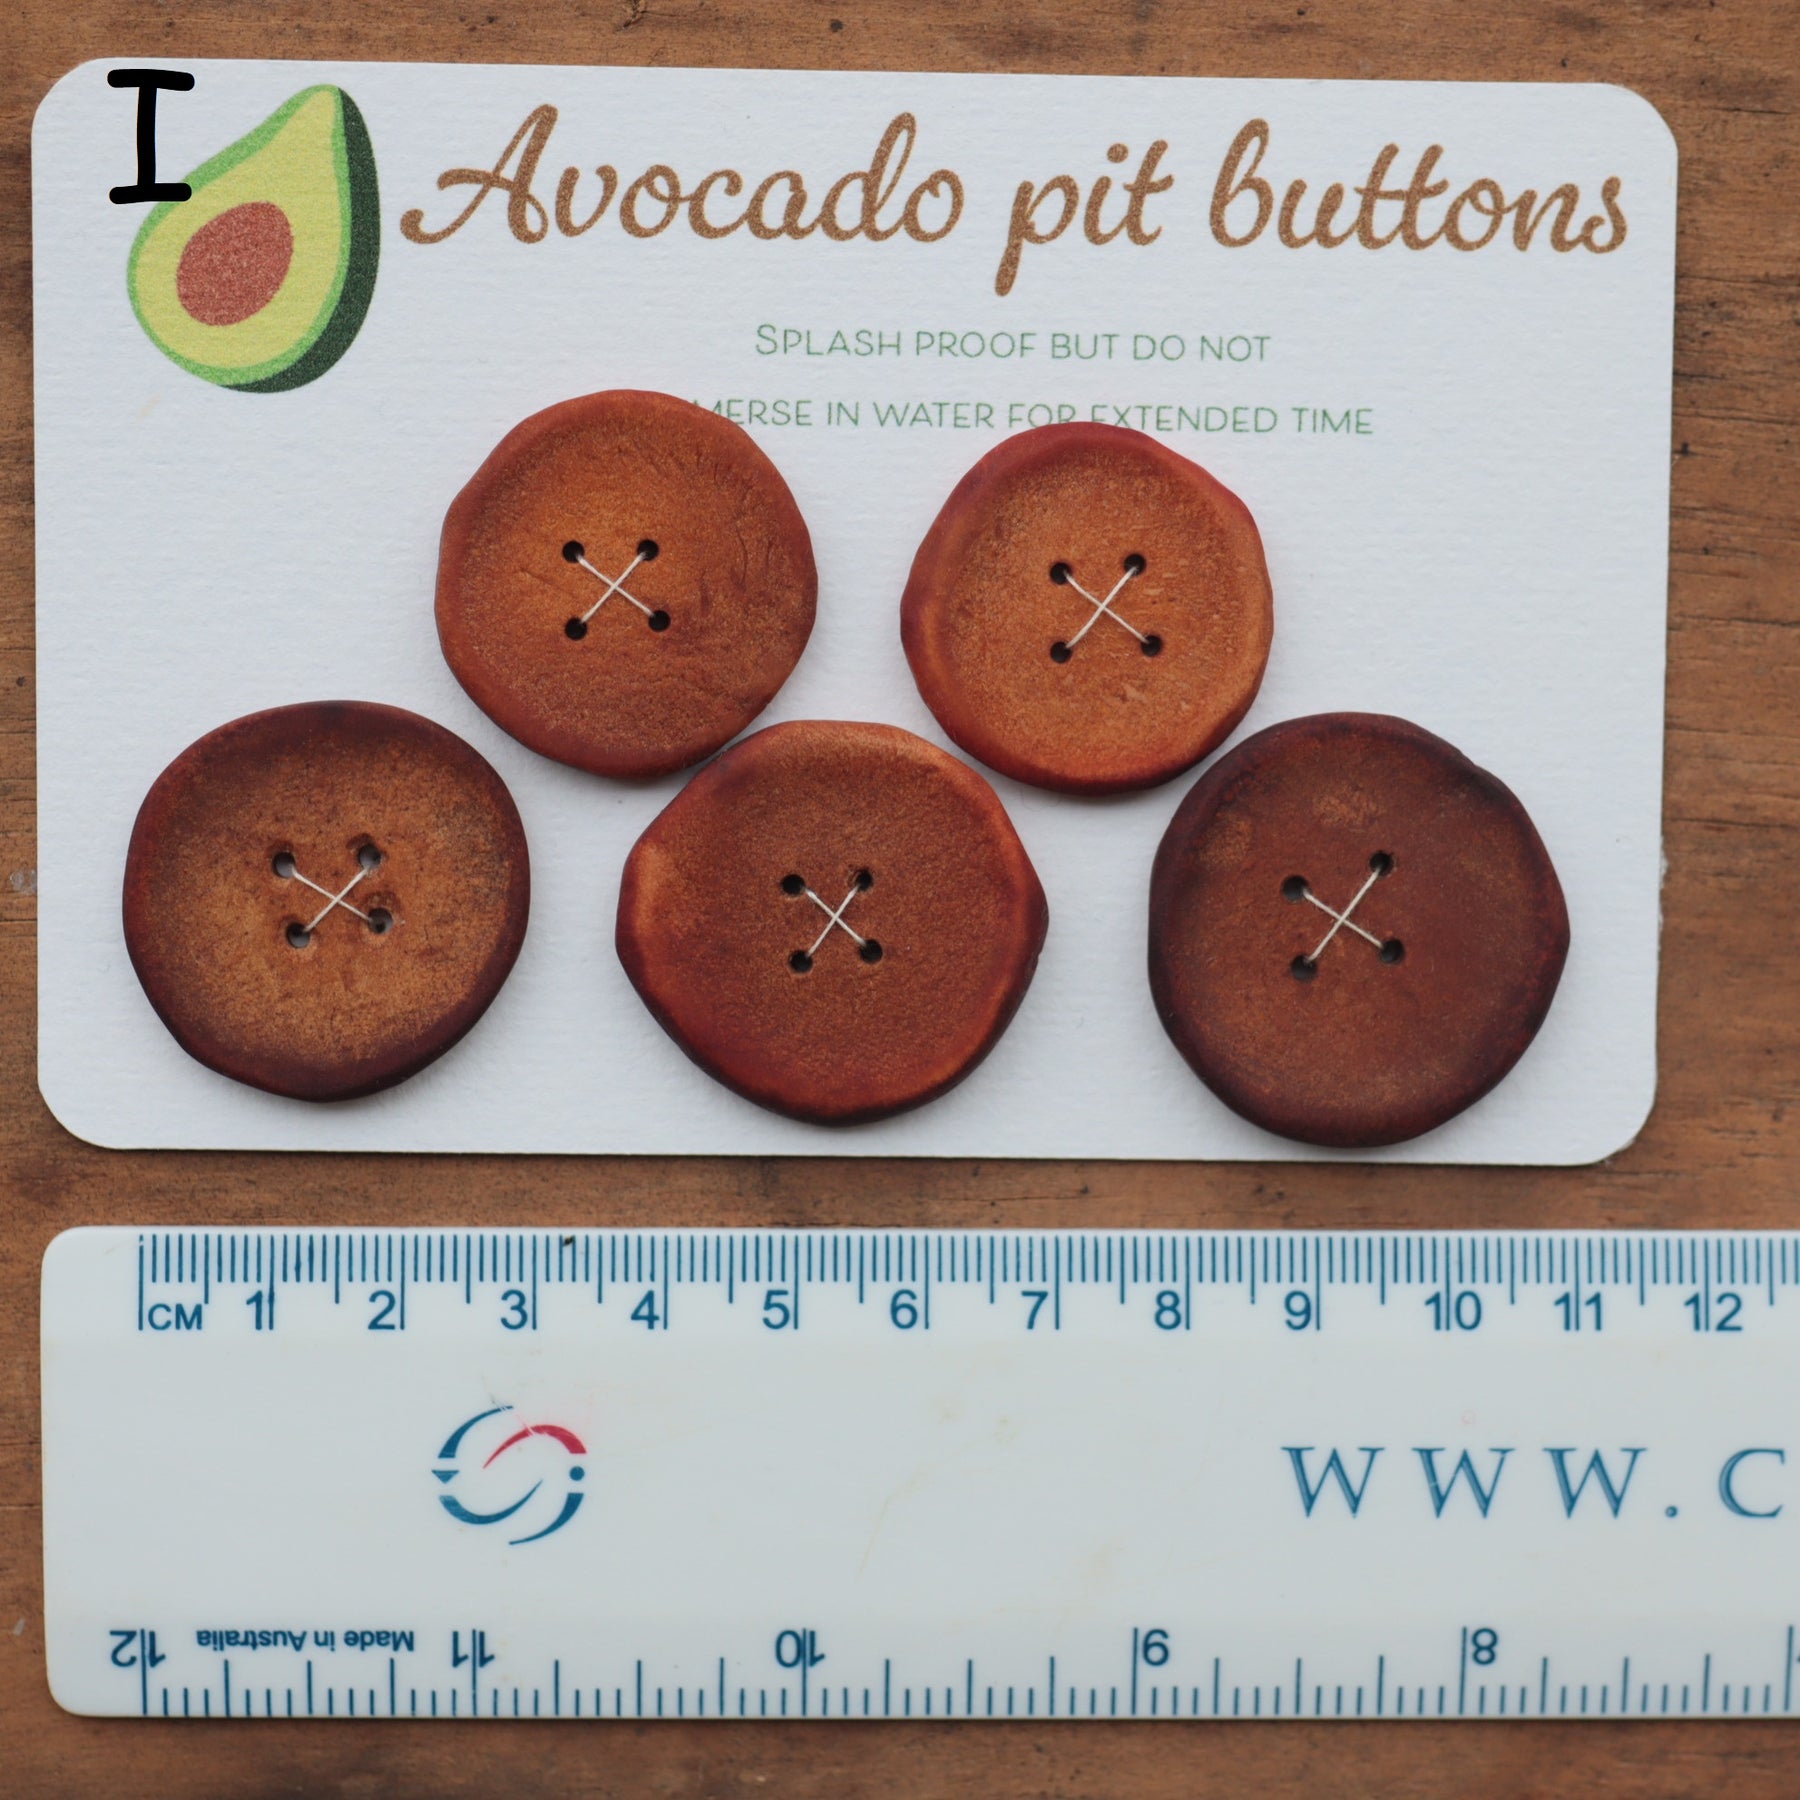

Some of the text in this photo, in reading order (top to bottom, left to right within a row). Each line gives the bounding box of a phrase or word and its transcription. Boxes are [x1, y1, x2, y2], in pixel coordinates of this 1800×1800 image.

[400, 104, 1628, 296] Avocado pit buttons
[755, 323, 1271, 361] SPLASH PROOF BUT DO NOT
[828, 402, 860, 426] IN
[873, 402, 994, 428] WATER
[1009, 404, 1077, 428] FOR
[1091, 405, 1278, 433] EXTENDED
[1293, 408, 1373, 434] TIME
[148, 1290, 1743, 1332] CM 1 2 3 4 5 6 7 8 9 10 11 12
[109, 1631, 166, 1668] 12
[196, 1630, 415, 1651] Made in Australia
[775, 1630, 825, 1667] 10
[1142, 1629, 1170, 1666] 9
[1472, 1627, 1498, 1665] 8
